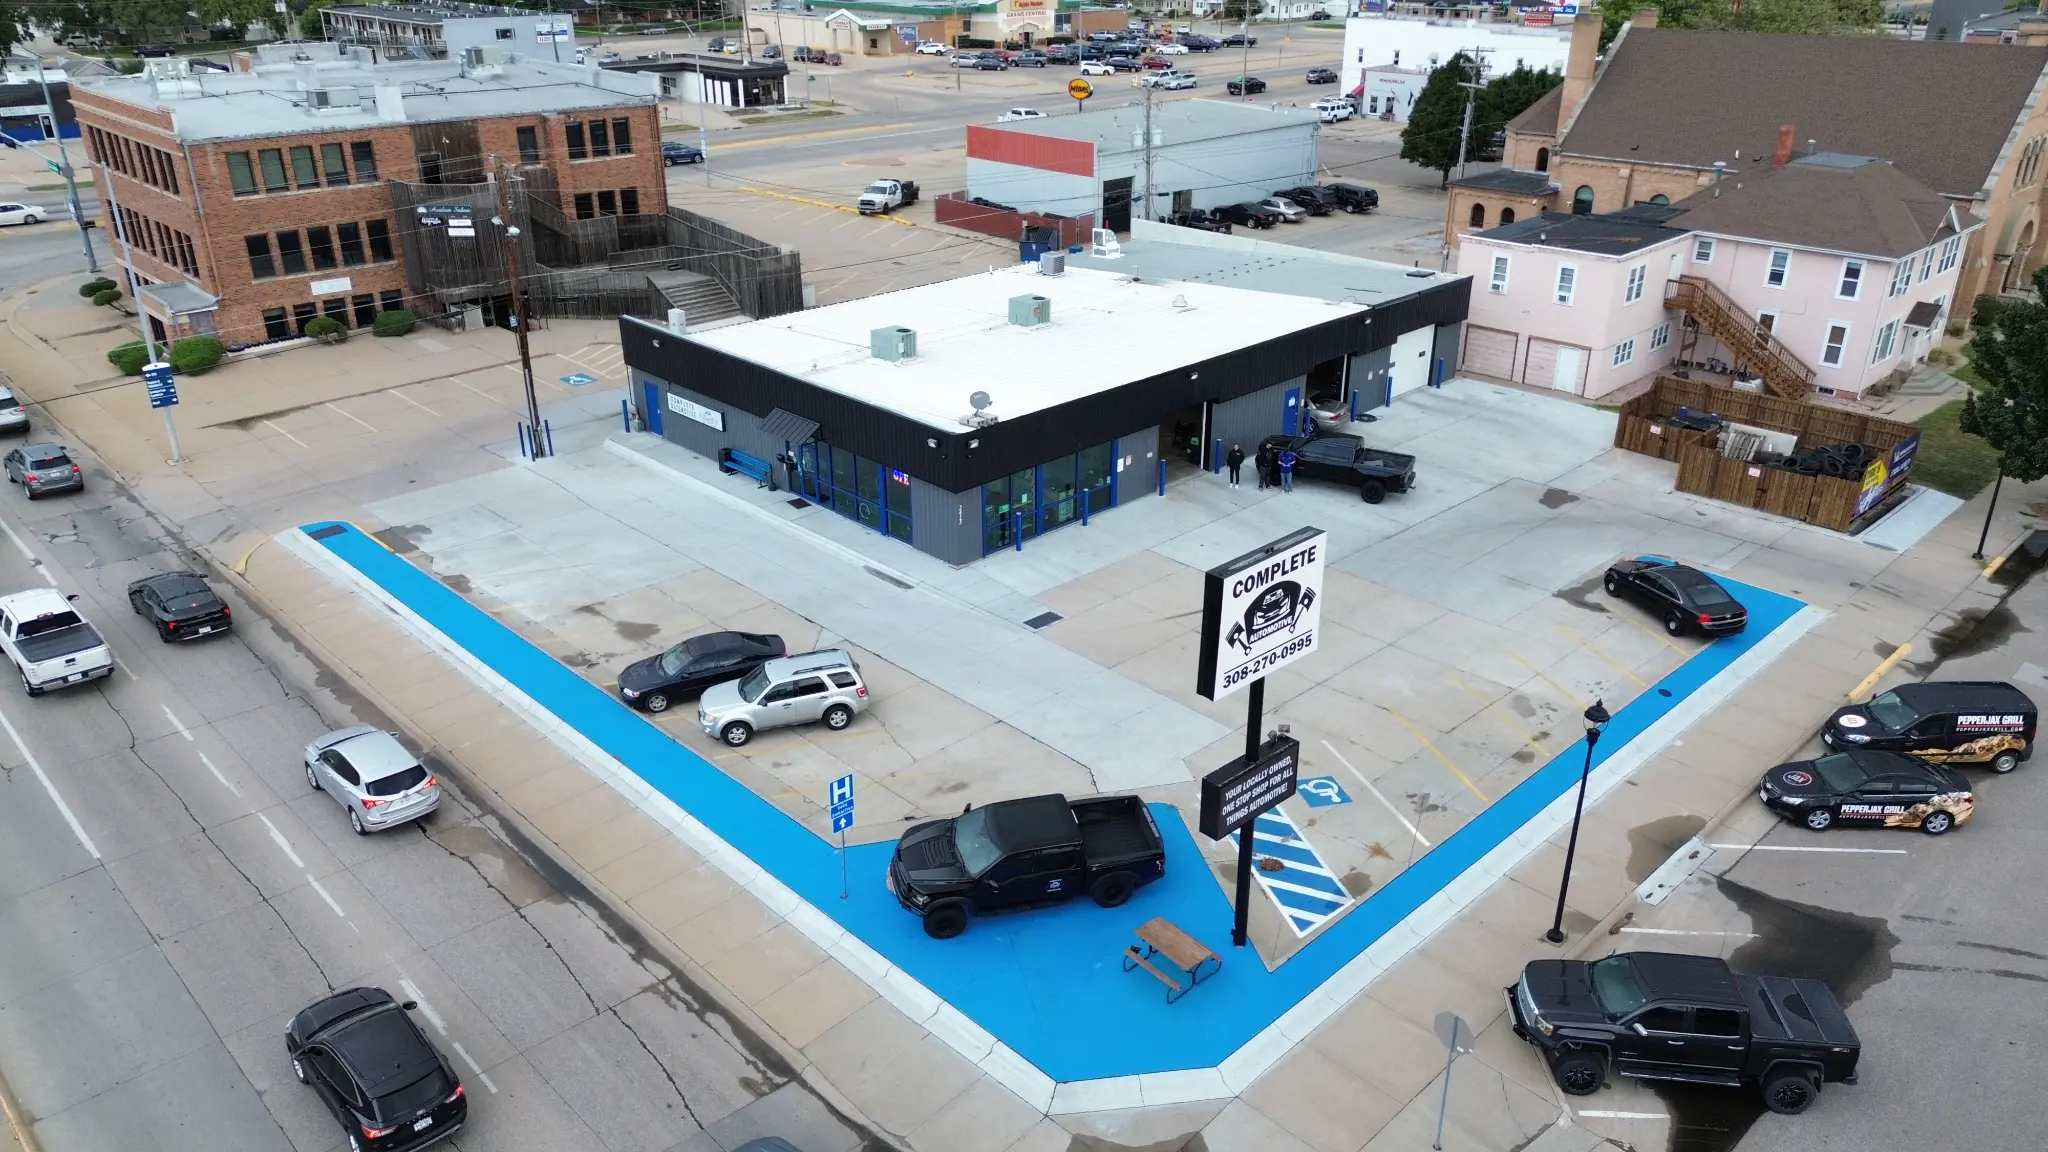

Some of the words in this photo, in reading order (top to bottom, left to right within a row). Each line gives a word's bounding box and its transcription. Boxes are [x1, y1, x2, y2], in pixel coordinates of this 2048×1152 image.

[893, 469, 910, 486] OPE
[1232, 544, 1317, 599] COMPLETE
[1249, 615, 1293, 643] AUTOMOTIVE
[1222, 633, 1313, 689] 308-270-0995
[1957, 715, 2001, 725] PEPPERJAX
[2001, 715, 2024, 725] GRILL
[832, 776, 851, 804] H
[1222, 800, 1236, 816] ONE
[1235, 790, 1252, 808] STOP
[1251, 780, 1269, 798] SHOP
[1269, 773, 1282, 788] FOR
[1282, 766, 1294, 780] ALL
[1225, 784, 1243, 802] YOUR
[1242, 768, 1269, 791] LOCALLY
[1268, 755, 1293, 775] OWNED,
[1226, 805, 1249, 827] THINGS
[1248, 781, 1288, 813] AUTOMOTIVE!
[1840, 804, 1884, 814] PEPPERJAX
[1883, 805, 1906, 814] GRILL
